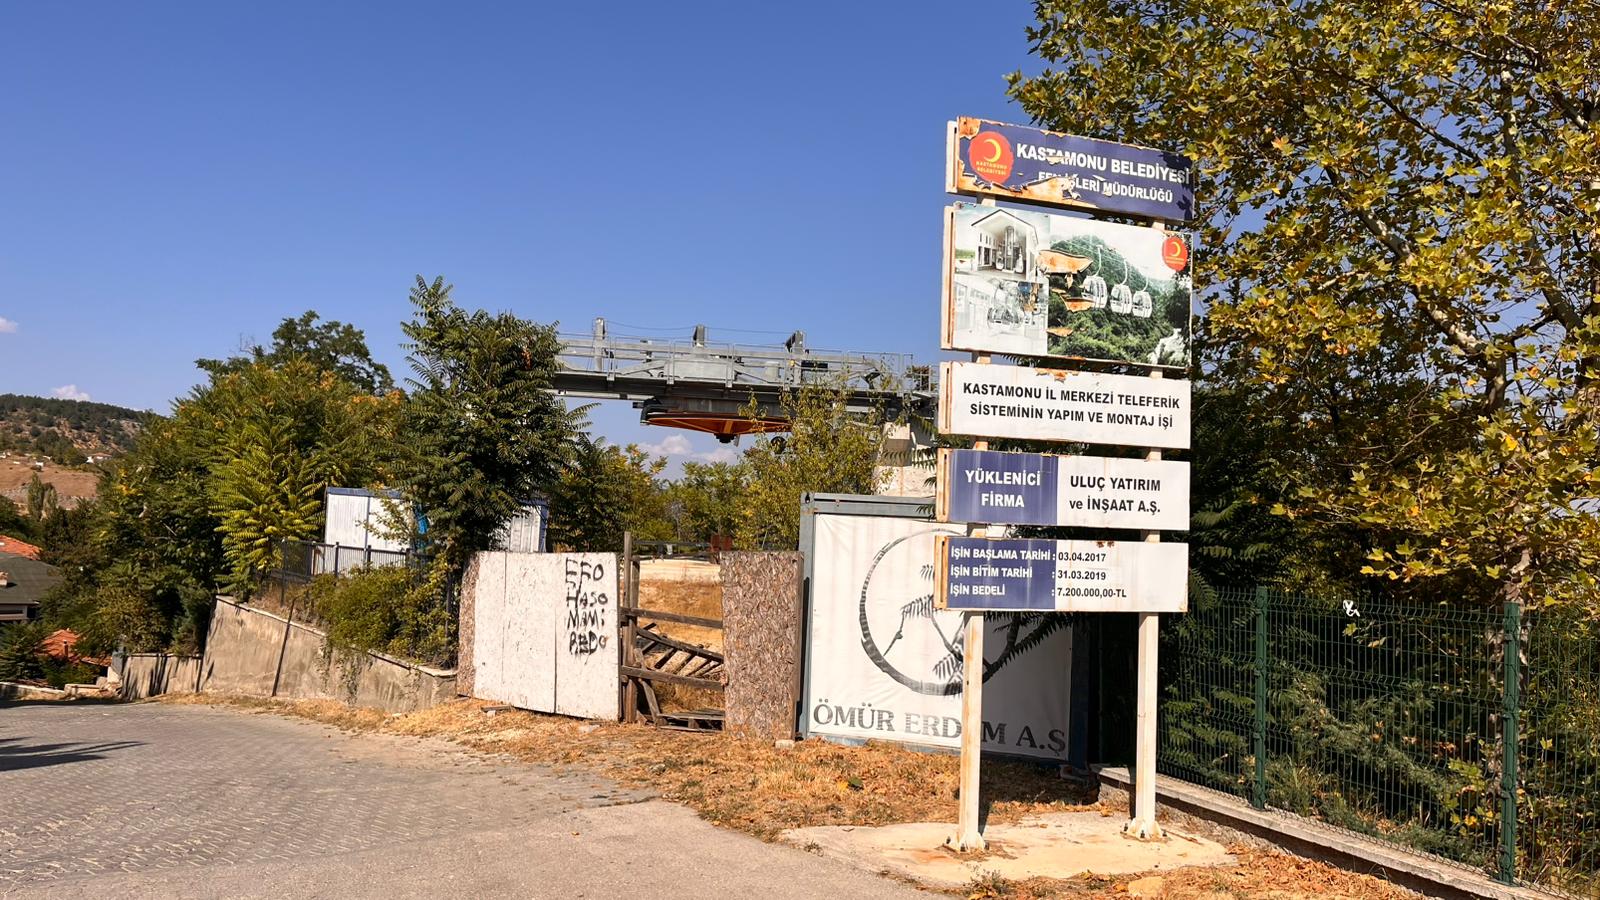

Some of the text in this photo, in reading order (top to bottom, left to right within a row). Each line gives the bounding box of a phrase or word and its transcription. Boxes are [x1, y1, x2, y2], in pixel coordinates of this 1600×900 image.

[1016, 143, 1190, 184] KASTAMONU BELEDİYESİ
[1103, 180, 1173, 203] MÜDÜRLÜĞÜ
[963, 382, 1180, 409] KASTAMONU İL MERKEZİ TELEFERİK
[970, 401, 1173, 430] SİSTEMİNİN YAPIM VE MONTAJ İŞİ
[965, 467, 1041, 486] YÜKLENİCİ
[1070, 475, 1161, 492] ULUÇ YATIRIM
[981, 490, 1025, 508] FİRMA
[1069, 495, 1161, 516] ve İNŞAAT A.Ş.
[951, 545, 971, 560] İŞİN
[972, 549, 1018, 562] BAŞLAMA
[1058, 552, 1106, 562] 03.04.2017
[950, 564, 970, 579] İŞİN
[972, 564, 999, 577] BİTİM
[1000, 566, 1033, 578] TARİHİ
[1057, 570, 1107, 581] 31.03.2019
[949, 582, 970, 598] İŞİN
[971, 583, 1006, 596] BEDELİ
[813, 698, 1066, 757] ÖMÜR ERDM A.Ş
